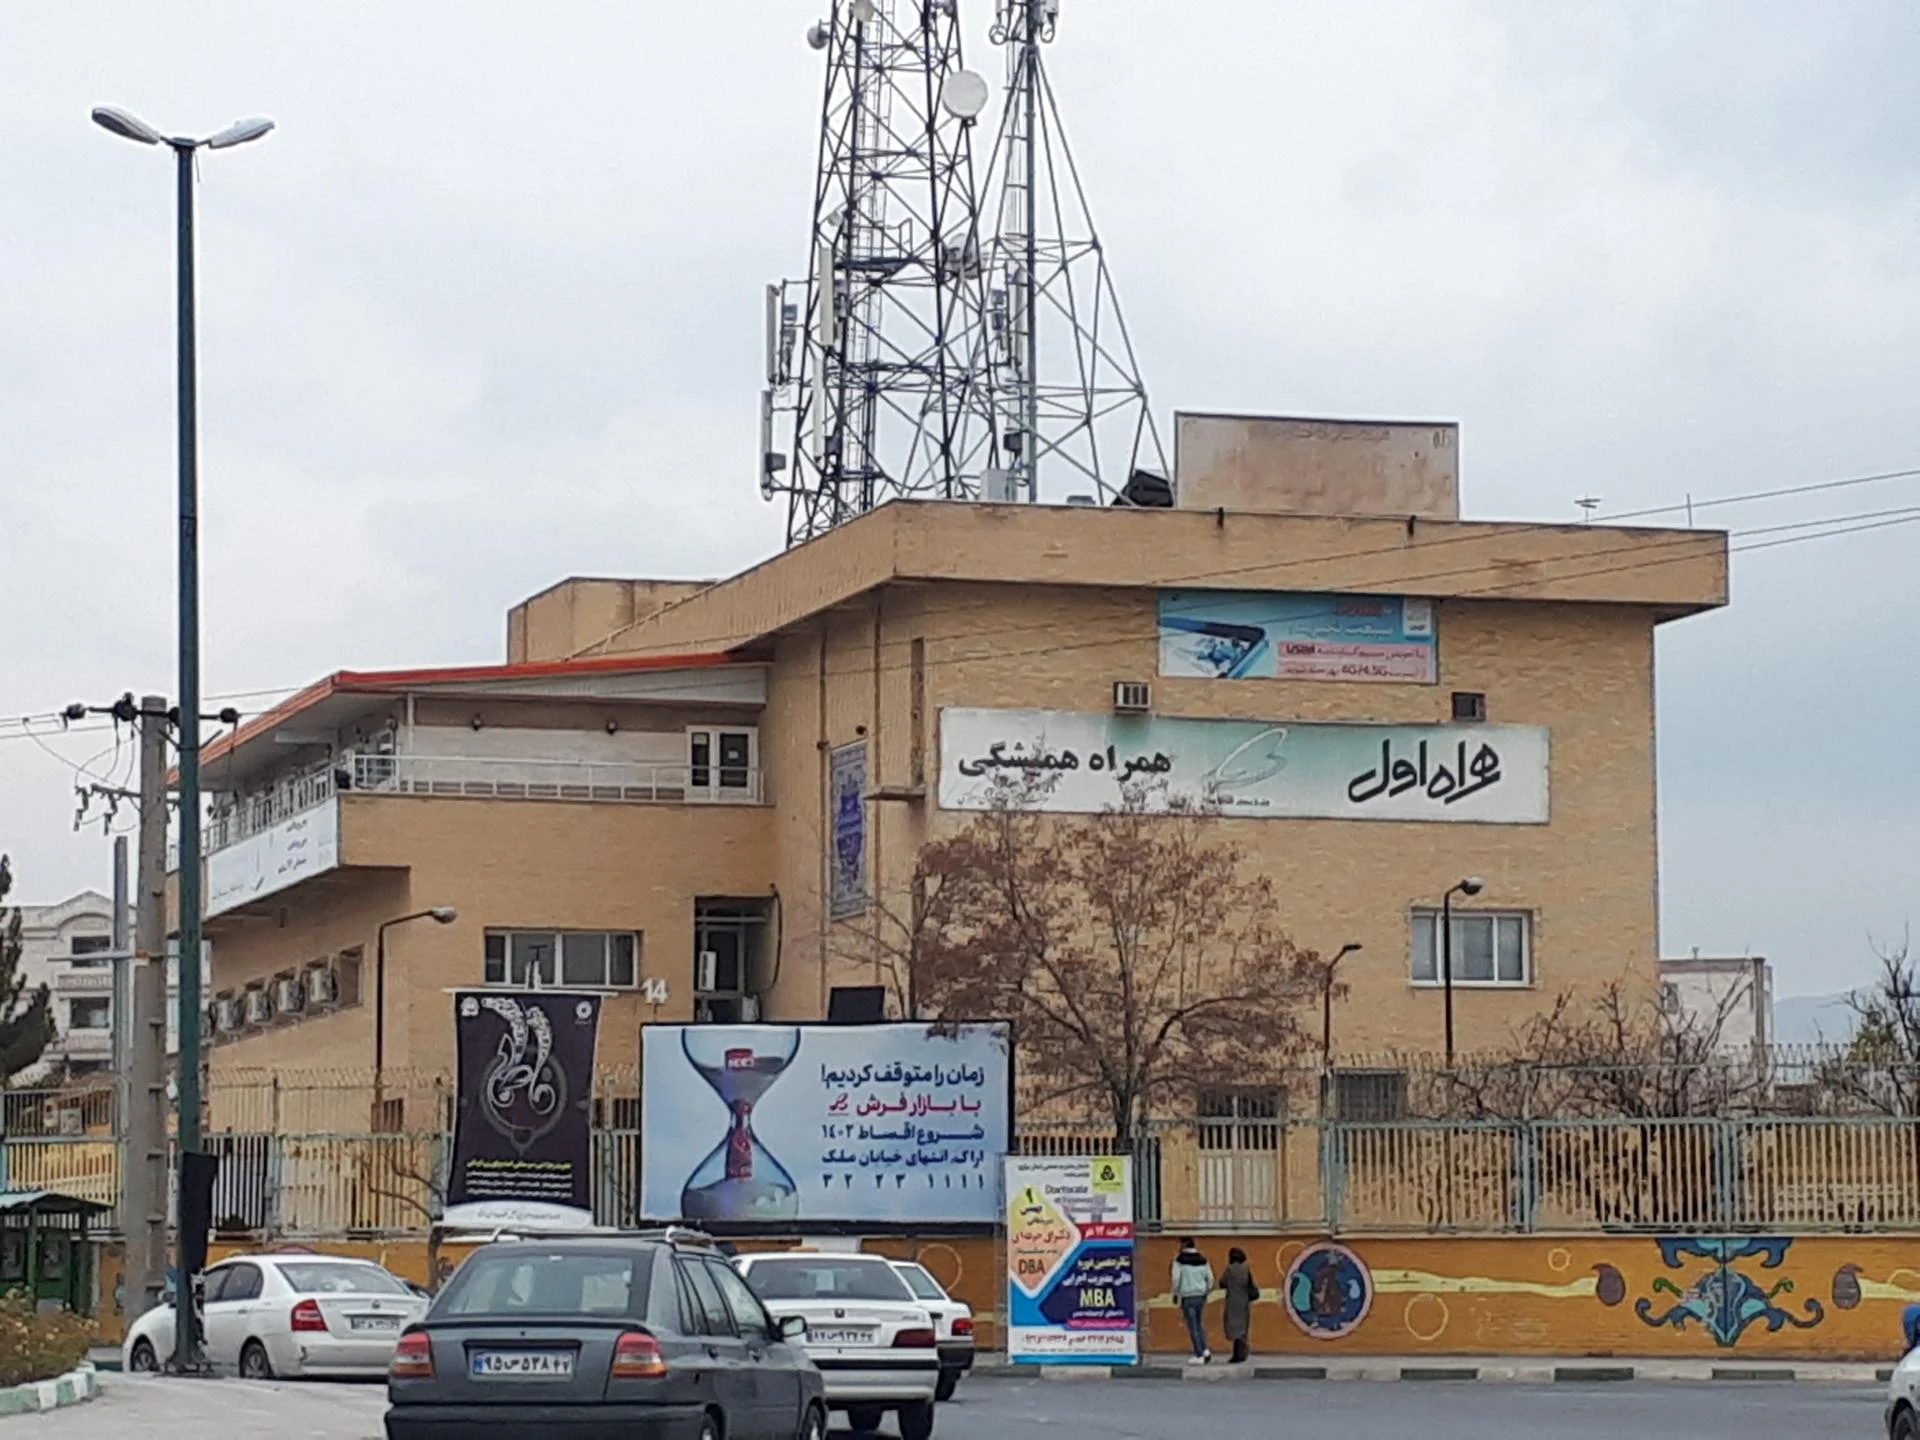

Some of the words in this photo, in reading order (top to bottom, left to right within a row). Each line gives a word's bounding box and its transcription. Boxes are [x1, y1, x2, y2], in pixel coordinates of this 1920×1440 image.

[1089, 744, 1172, 782] همراه
[1348, 738, 1427, 803] اول
[641, 977, 669, 1004] 14
[821, 1063, 873, 1090] کردیم!
[874, 1061, 933, 1088] متوقف
[934, 1063, 945, 1088] را
[946, 1063, 985, 1088] زمان
[856, 1091, 908, 1117] فرش
[909, 1092, 957, 1117] بازار
[960, 1093, 982, 1118] با
[857, 1120, 916, 1140] اقساط
[916, 1122, 985, 1146] شروع
[821, 1149, 857, 1164] ملک
[858, 1149, 902, 1168] خیابان
[905, 1149, 949, 1167] انتهای
[1018, 1258, 1046, 1275] DBA
[1079, 1288, 1116, 1309] MBA
